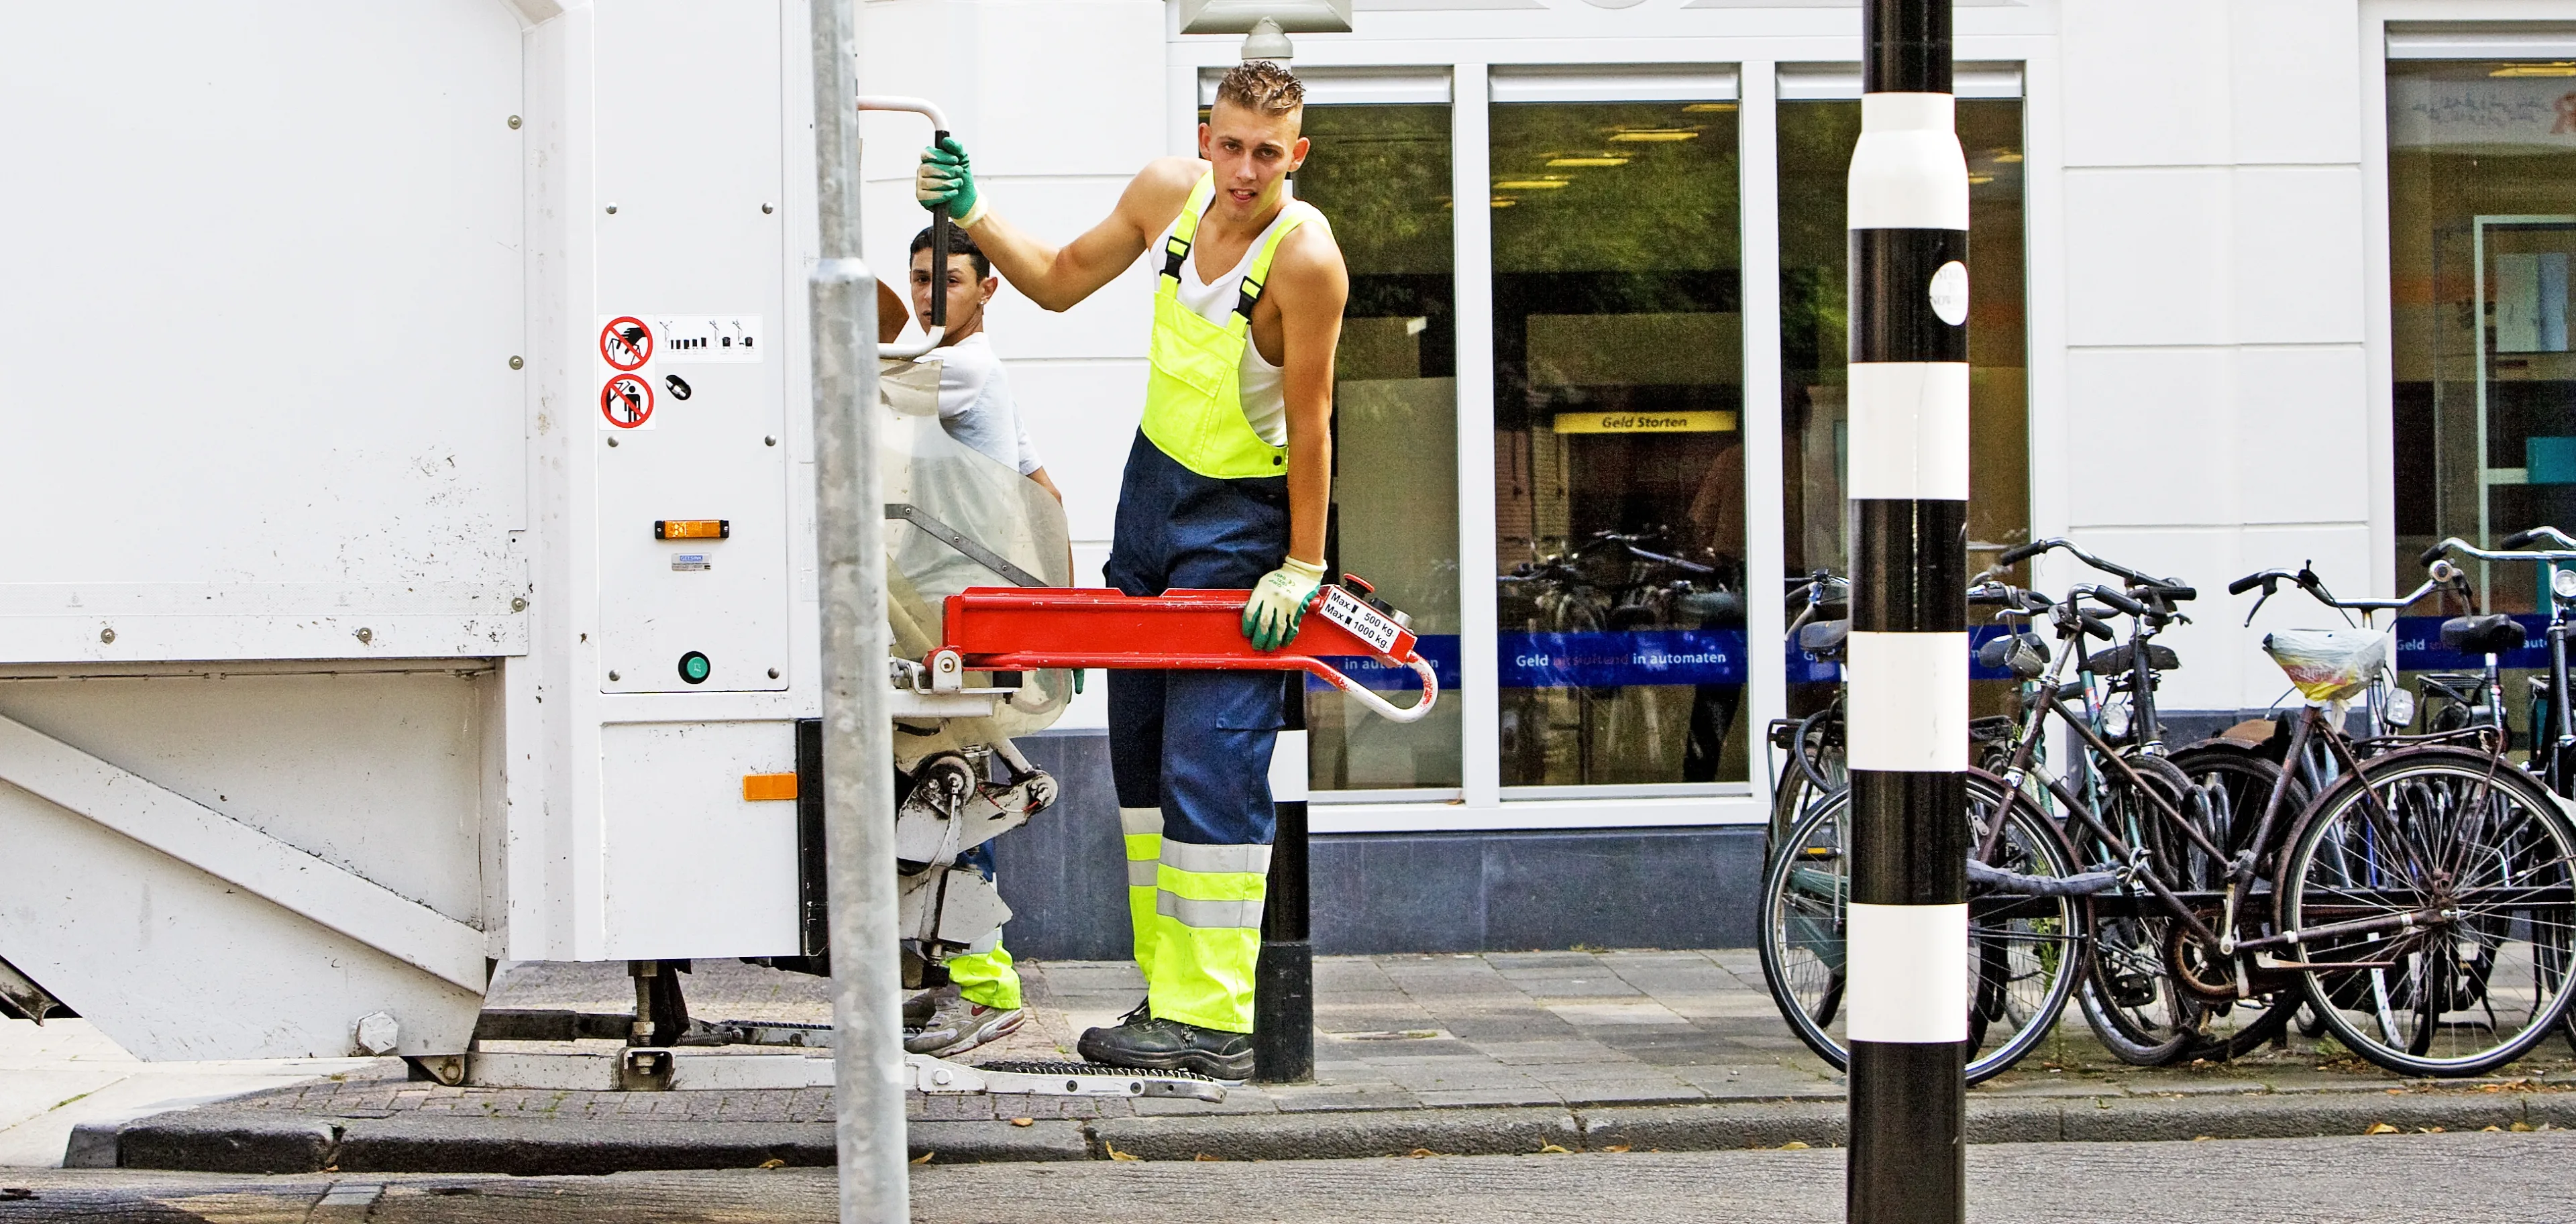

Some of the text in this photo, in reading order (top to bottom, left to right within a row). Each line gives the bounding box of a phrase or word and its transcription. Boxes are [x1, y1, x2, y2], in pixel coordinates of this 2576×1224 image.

[1603, 416, 1687, 428] Geld Storten
[1331, 592, 1351, 611] Max.
[1364, 613, 1381, 627] 500
[1325, 604, 1389, 649] Max. 1000 kg.
[2396, 638, 2425, 651] Geld
[1345, 657, 1358, 669] in
[1516, 655, 1548, 667] Geld
[1633, 653, 1646, 664] in
[1650, 653, 1726, 664] automaten
